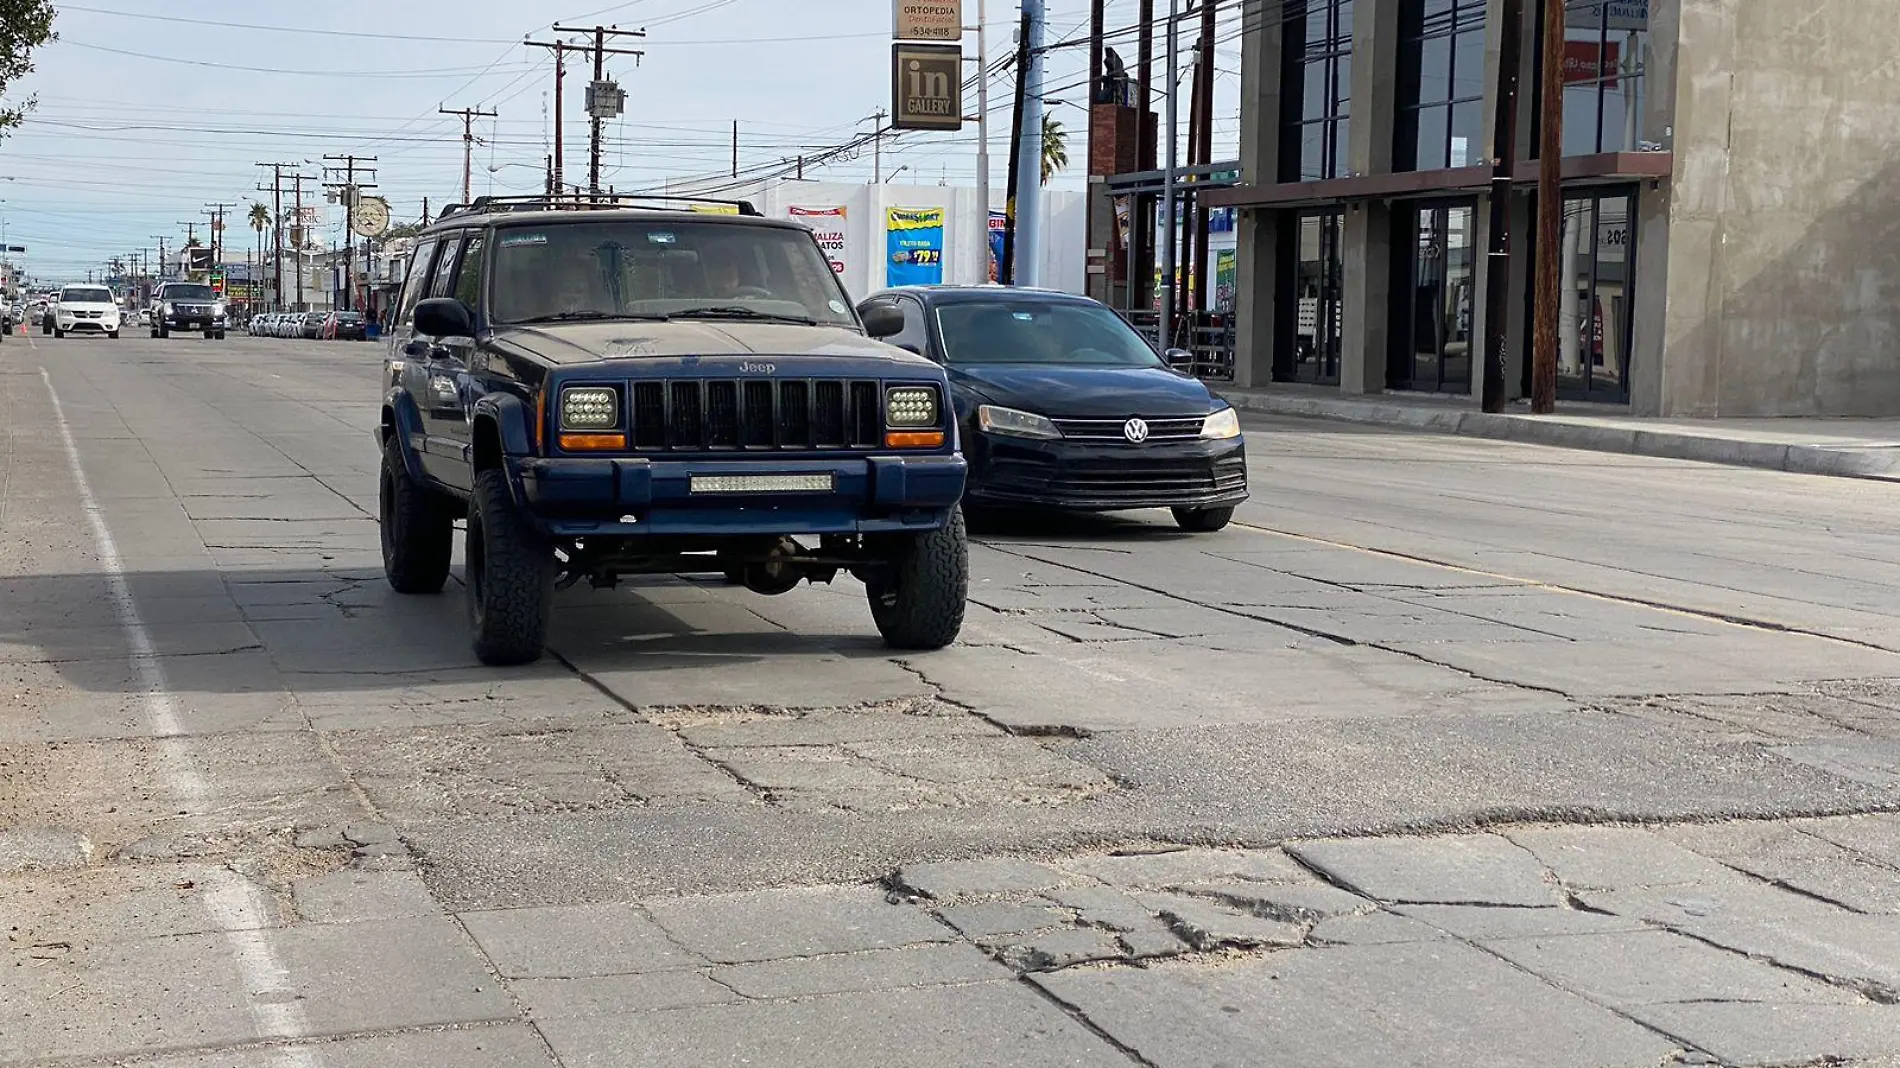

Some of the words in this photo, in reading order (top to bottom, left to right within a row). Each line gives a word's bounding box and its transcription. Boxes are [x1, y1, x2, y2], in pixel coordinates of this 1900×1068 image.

[904, 6, 955, 15] ORTOPEDIA
[908, 60, 949, 98] in
[908, 99, 950, 114] GALLERY
[739, 361, 776, 375] Jeep
